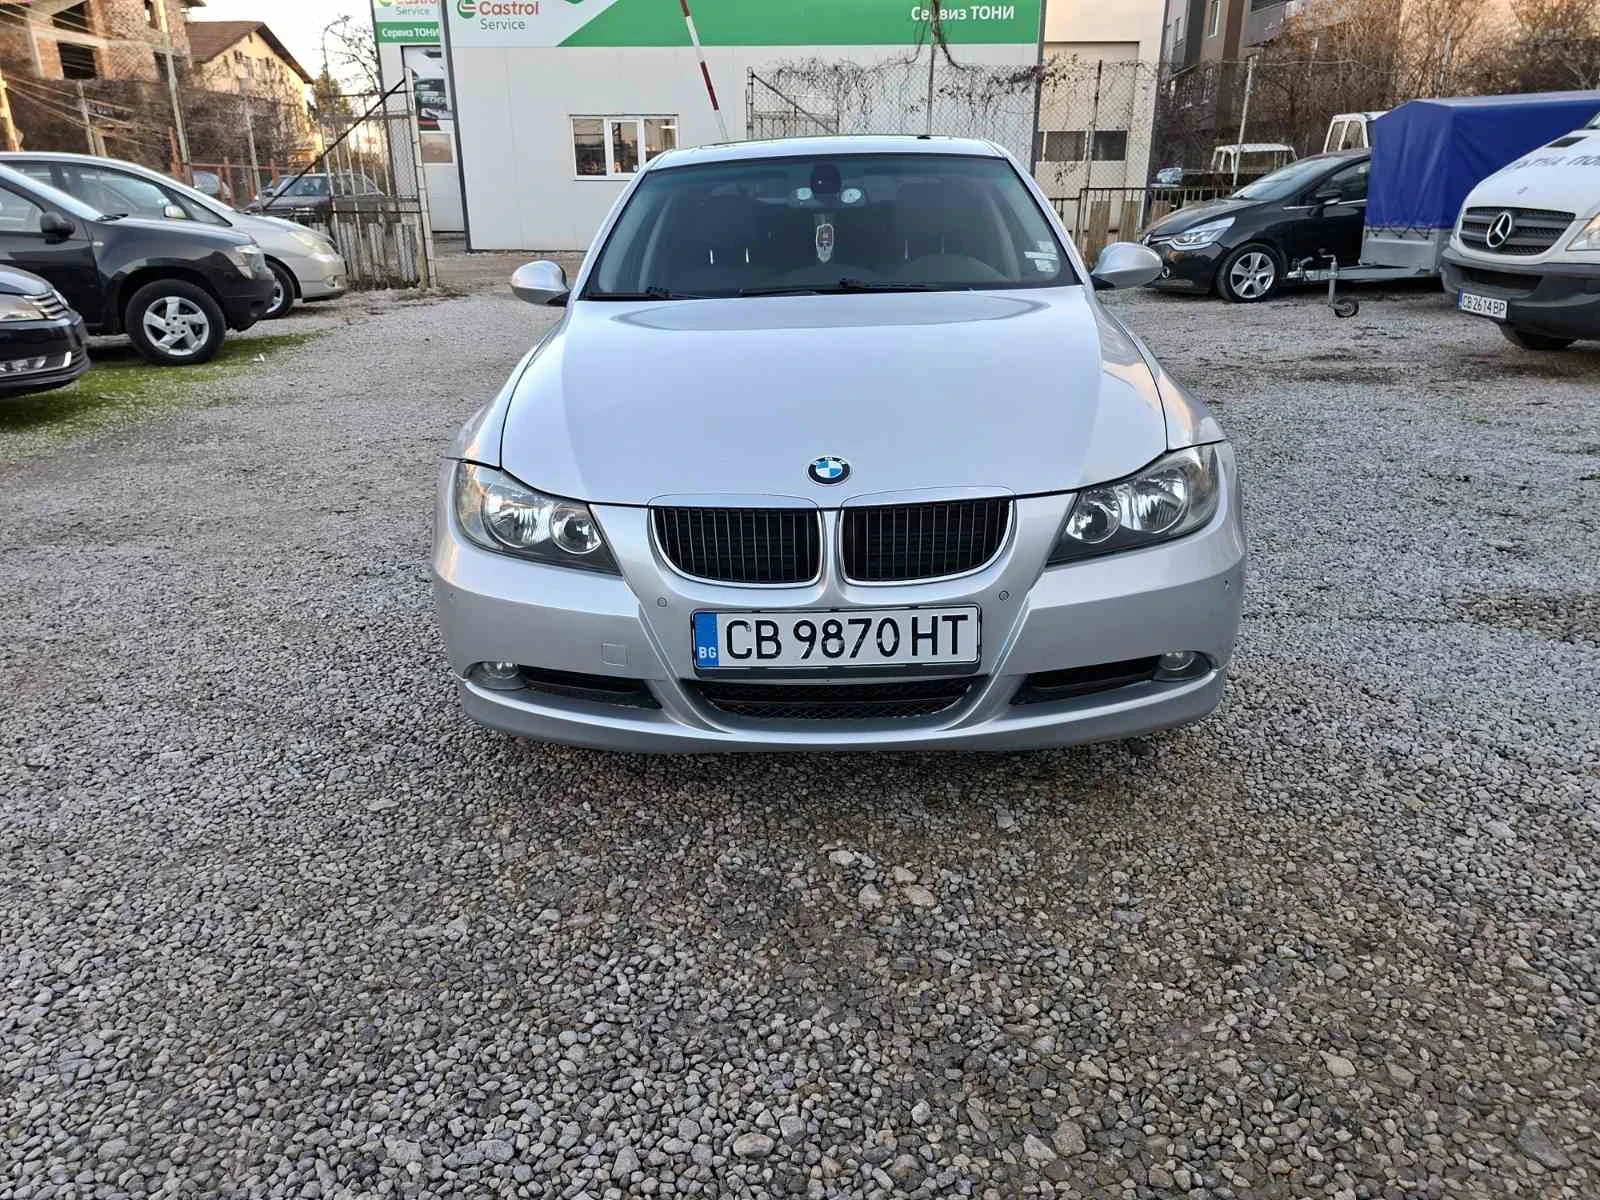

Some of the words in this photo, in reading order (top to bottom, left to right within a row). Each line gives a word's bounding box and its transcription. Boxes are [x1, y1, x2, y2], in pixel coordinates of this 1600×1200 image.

[480, 1, 539, 15] Castrol
[970, 5, 1015, 20] ТОНИ
[480, 18, 526, 31] Service
[726, 620, 782, 659] CB
[793, 618, 900, 658] 9870
[911, 615, 969, 656] HT
[698, 646, 717, 659] BG
